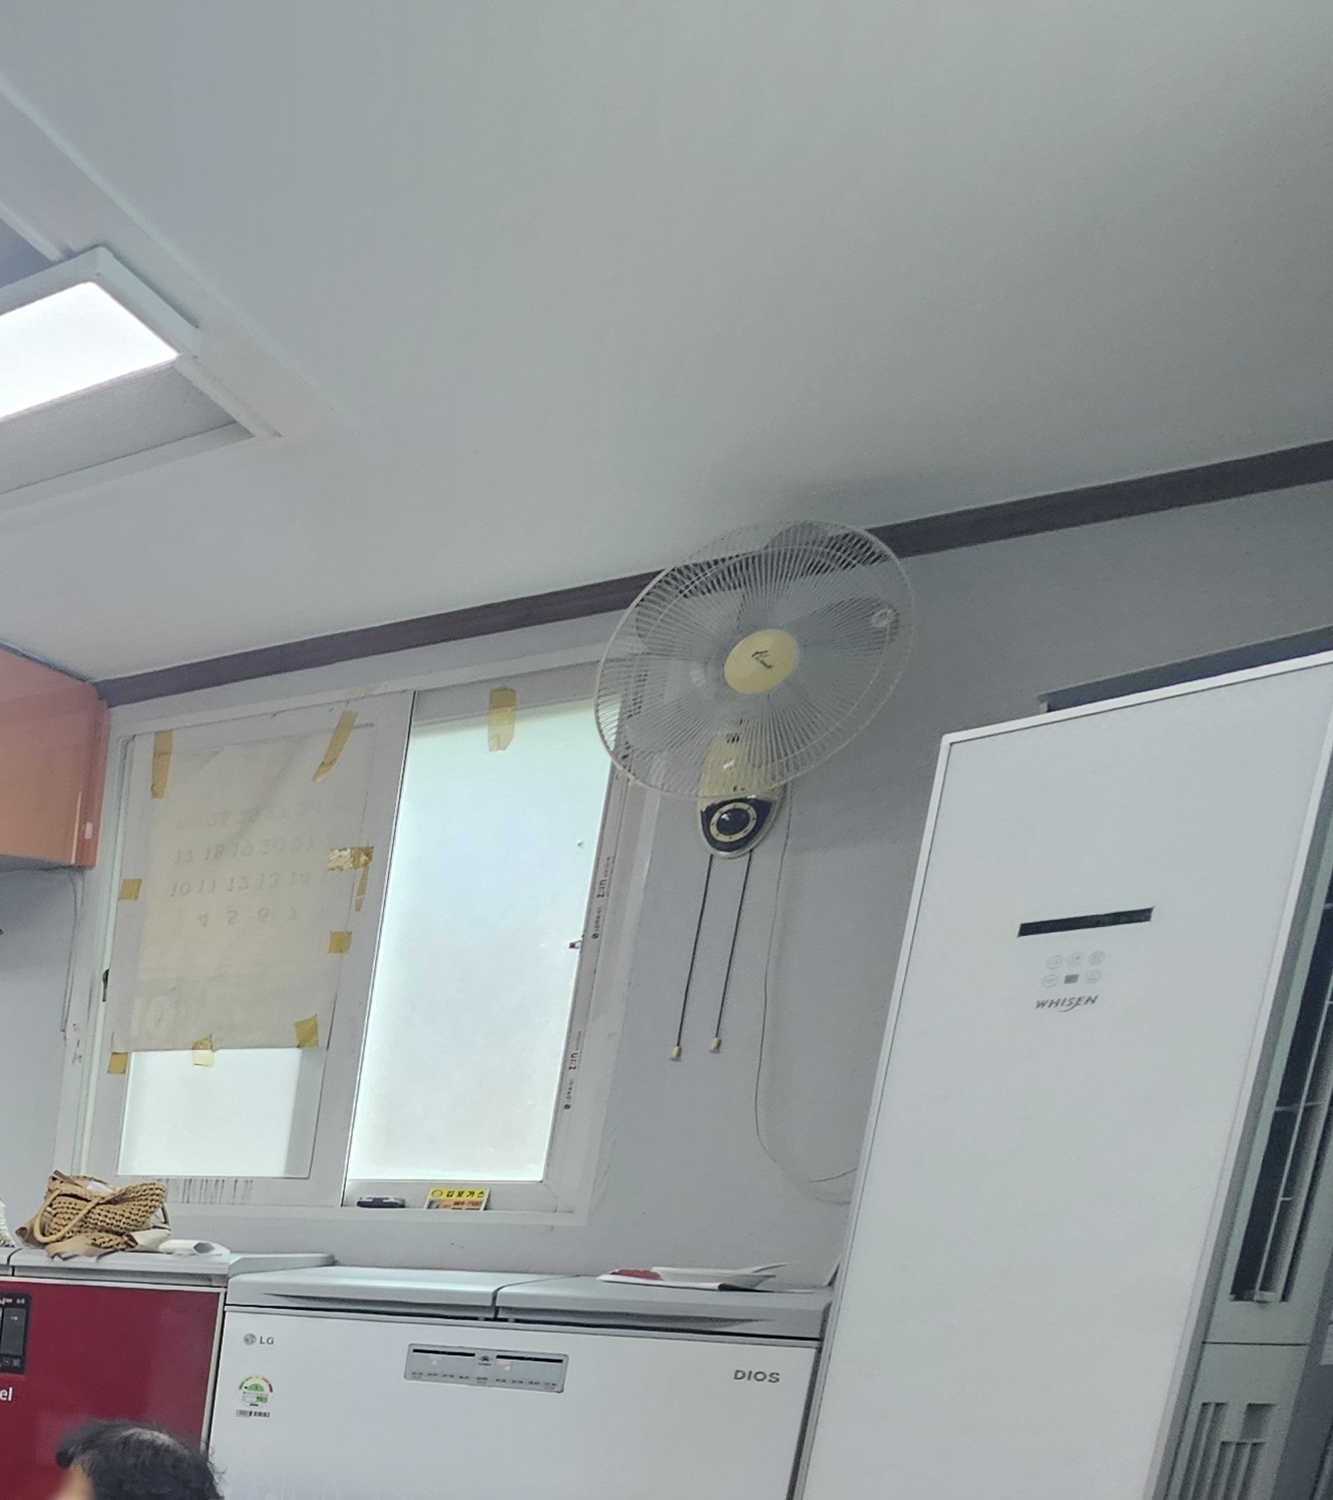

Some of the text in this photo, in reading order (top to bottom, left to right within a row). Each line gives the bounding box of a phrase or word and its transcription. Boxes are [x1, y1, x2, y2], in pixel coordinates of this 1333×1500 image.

[1035, 995, 1099, 1012] WHISEN
[259, 1335, 275, 1345] LG
[734, 1369, 781, 1384] DIOS
